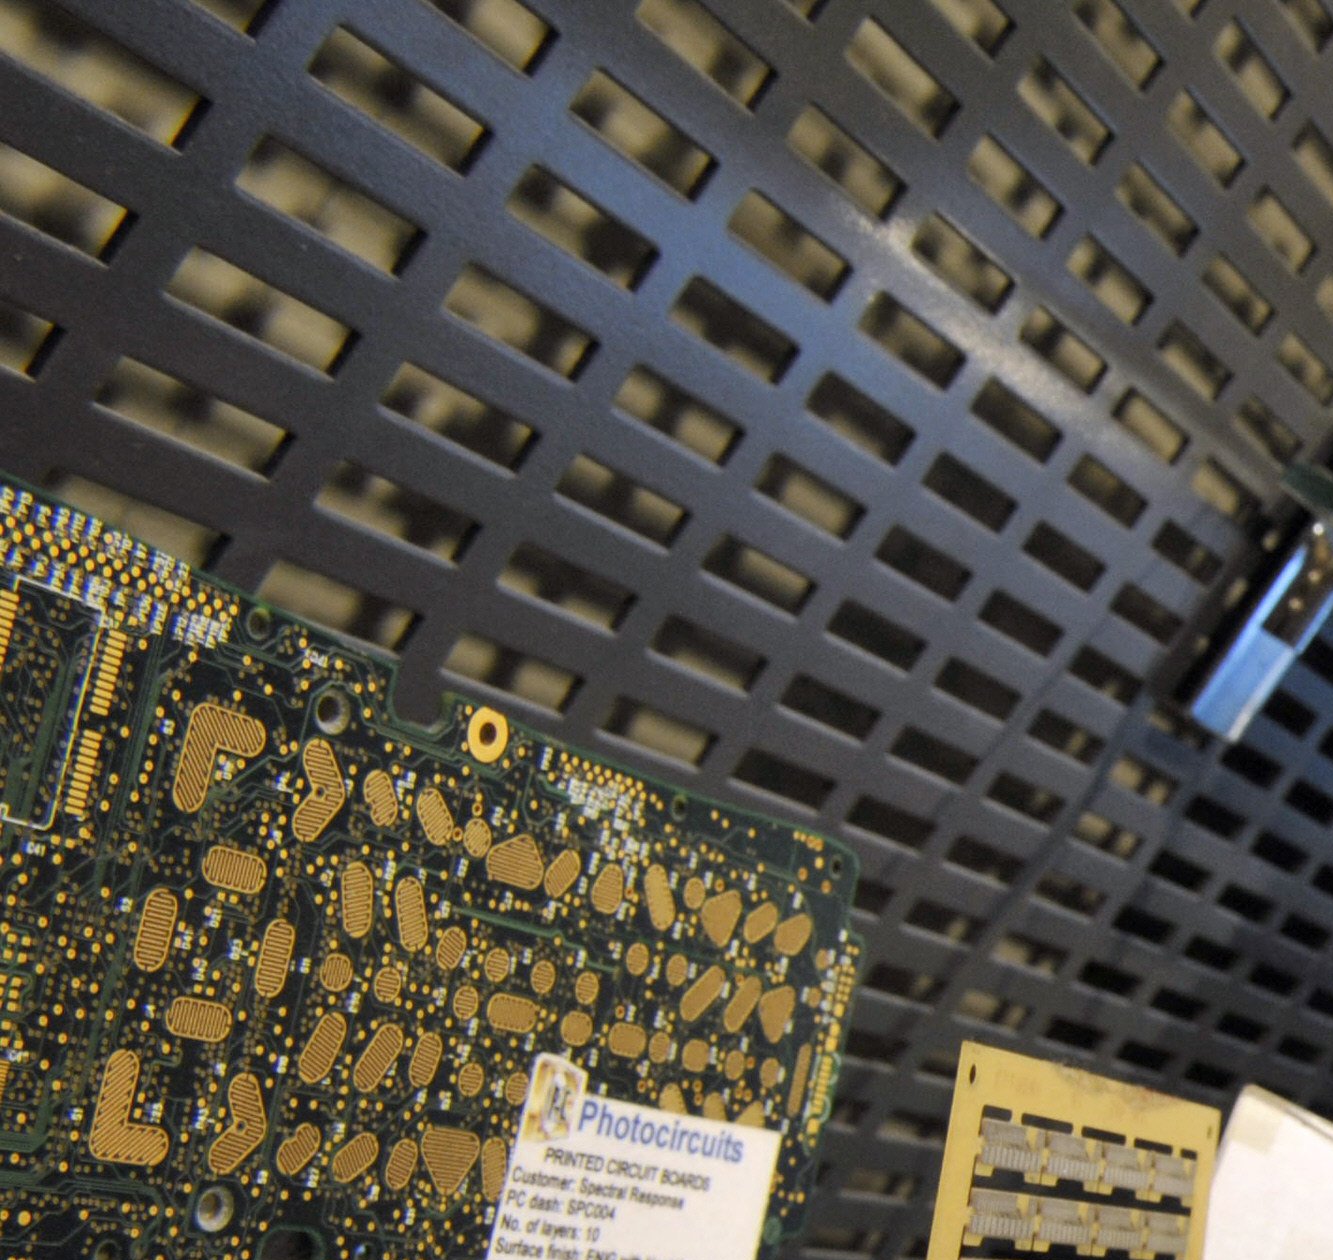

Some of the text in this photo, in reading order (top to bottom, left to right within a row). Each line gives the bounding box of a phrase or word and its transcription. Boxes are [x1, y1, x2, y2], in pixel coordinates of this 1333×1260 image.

[577, 1099, 745, 1164] Photocircuits
[511, 1166, 685, 1211] Customer: Spectral Response
[544, 1147, 711, 1192] PRINTED CIRCUIT BOARDS
[506, 1189, 616, 1221] PC dash: SPC004
[494, 1236, 545, 1259] Surface
[500, 1214, 602, 1243] No. of layers: 10
